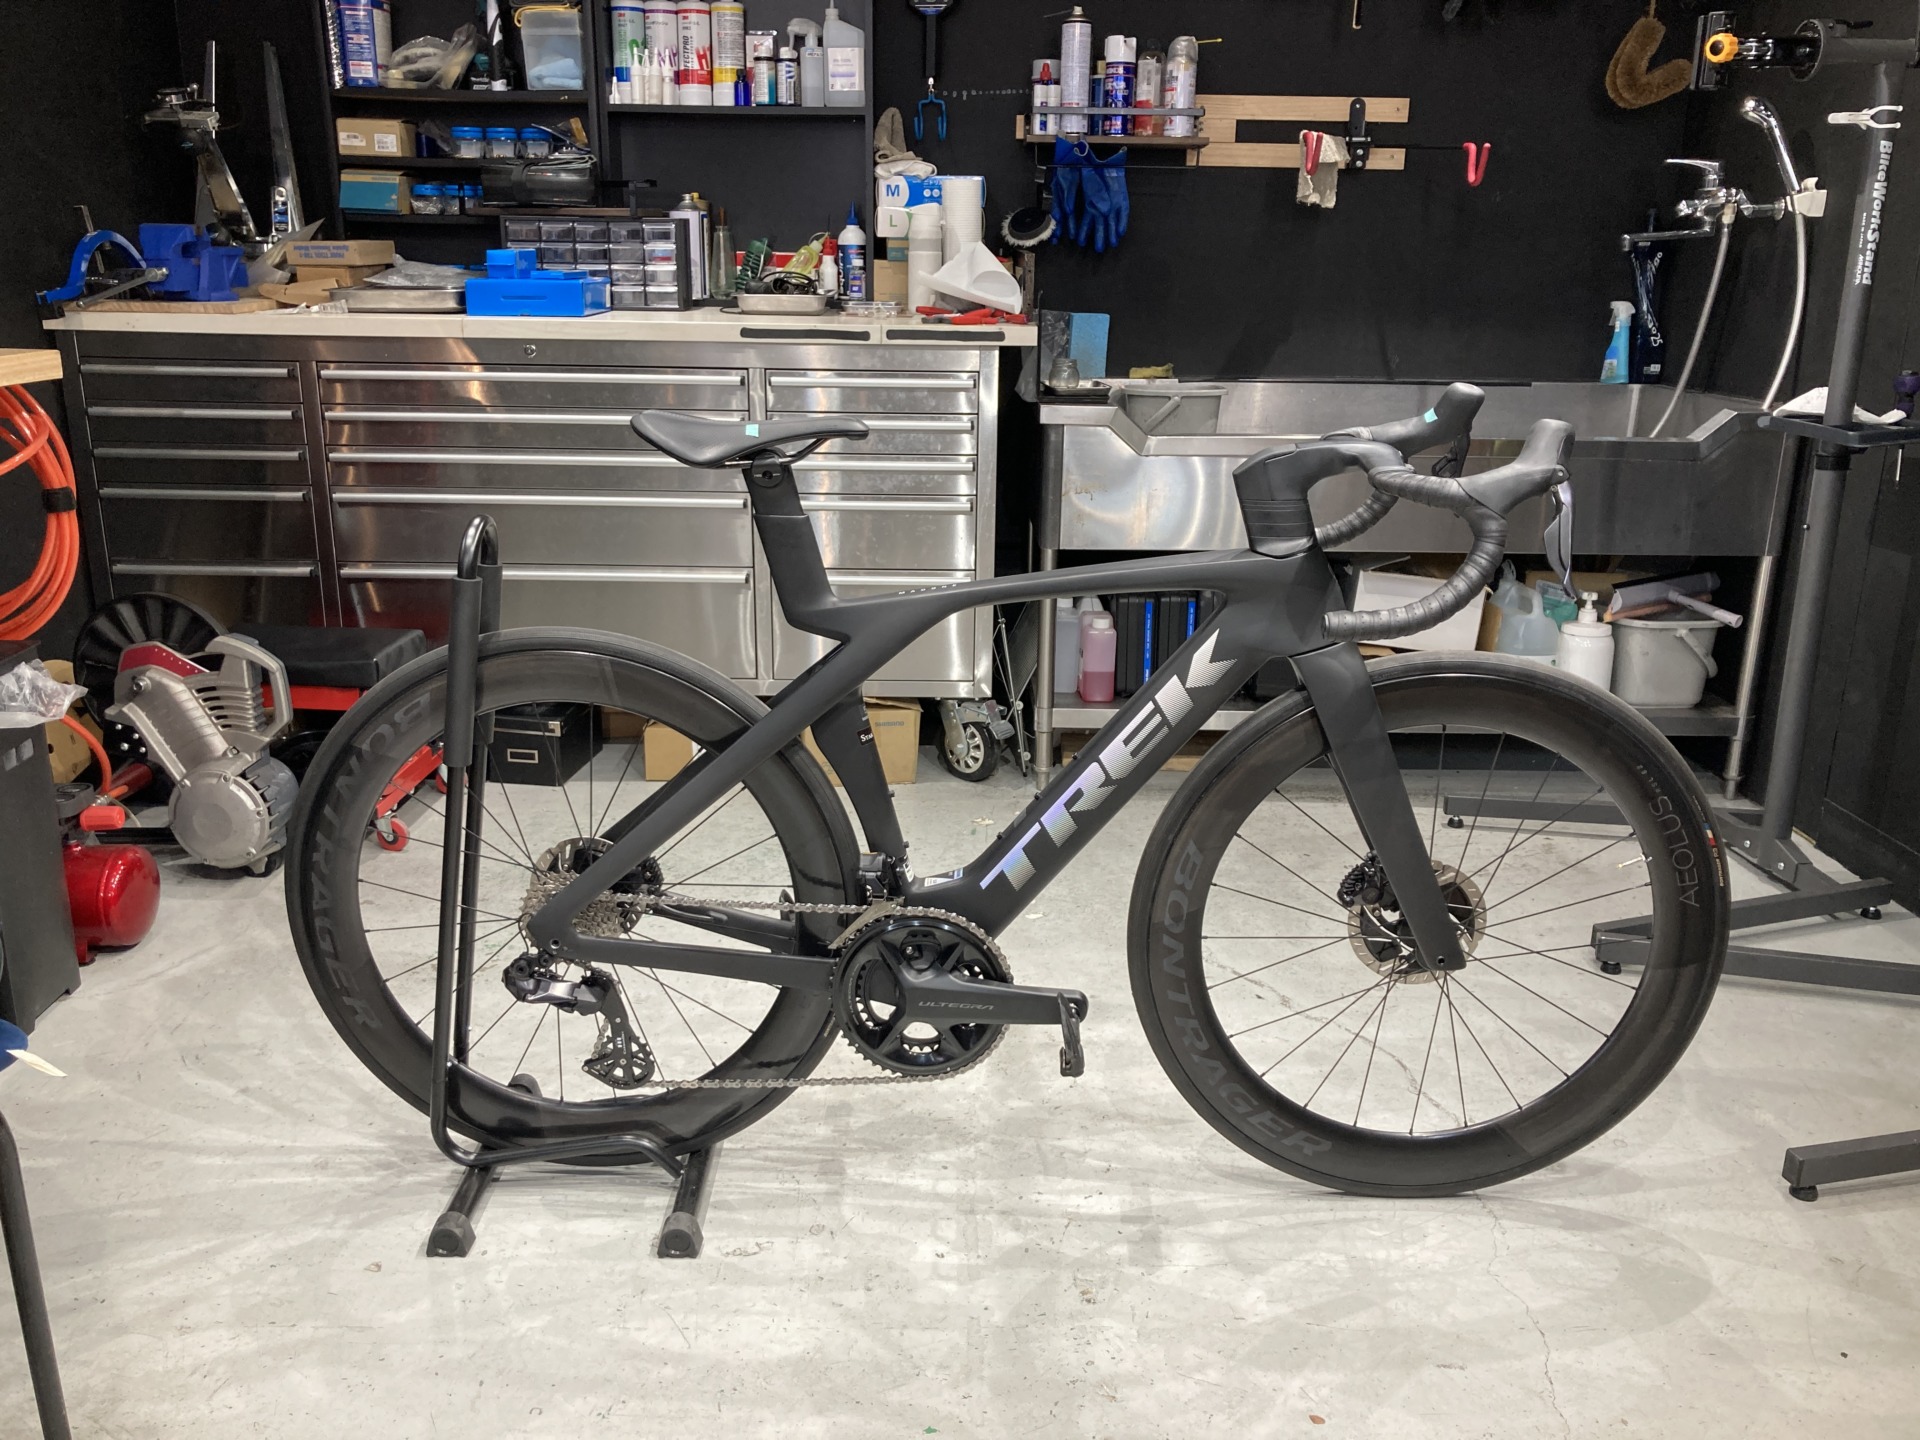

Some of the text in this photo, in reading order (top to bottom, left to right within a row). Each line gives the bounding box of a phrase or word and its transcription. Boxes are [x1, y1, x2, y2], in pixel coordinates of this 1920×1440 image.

[886, 184, 900, 197] M
[889, 214, 898, 227] L
[979, 627, 1238, 892] TREK
[310, 693, 431, 1032] BONTRAGER
[1650, 796, 1700, 907] AEOLUS
[918, 1001, 995, 1010] ULTEGRA
[1163, 839, 1332, 1157] BONTRAGER
